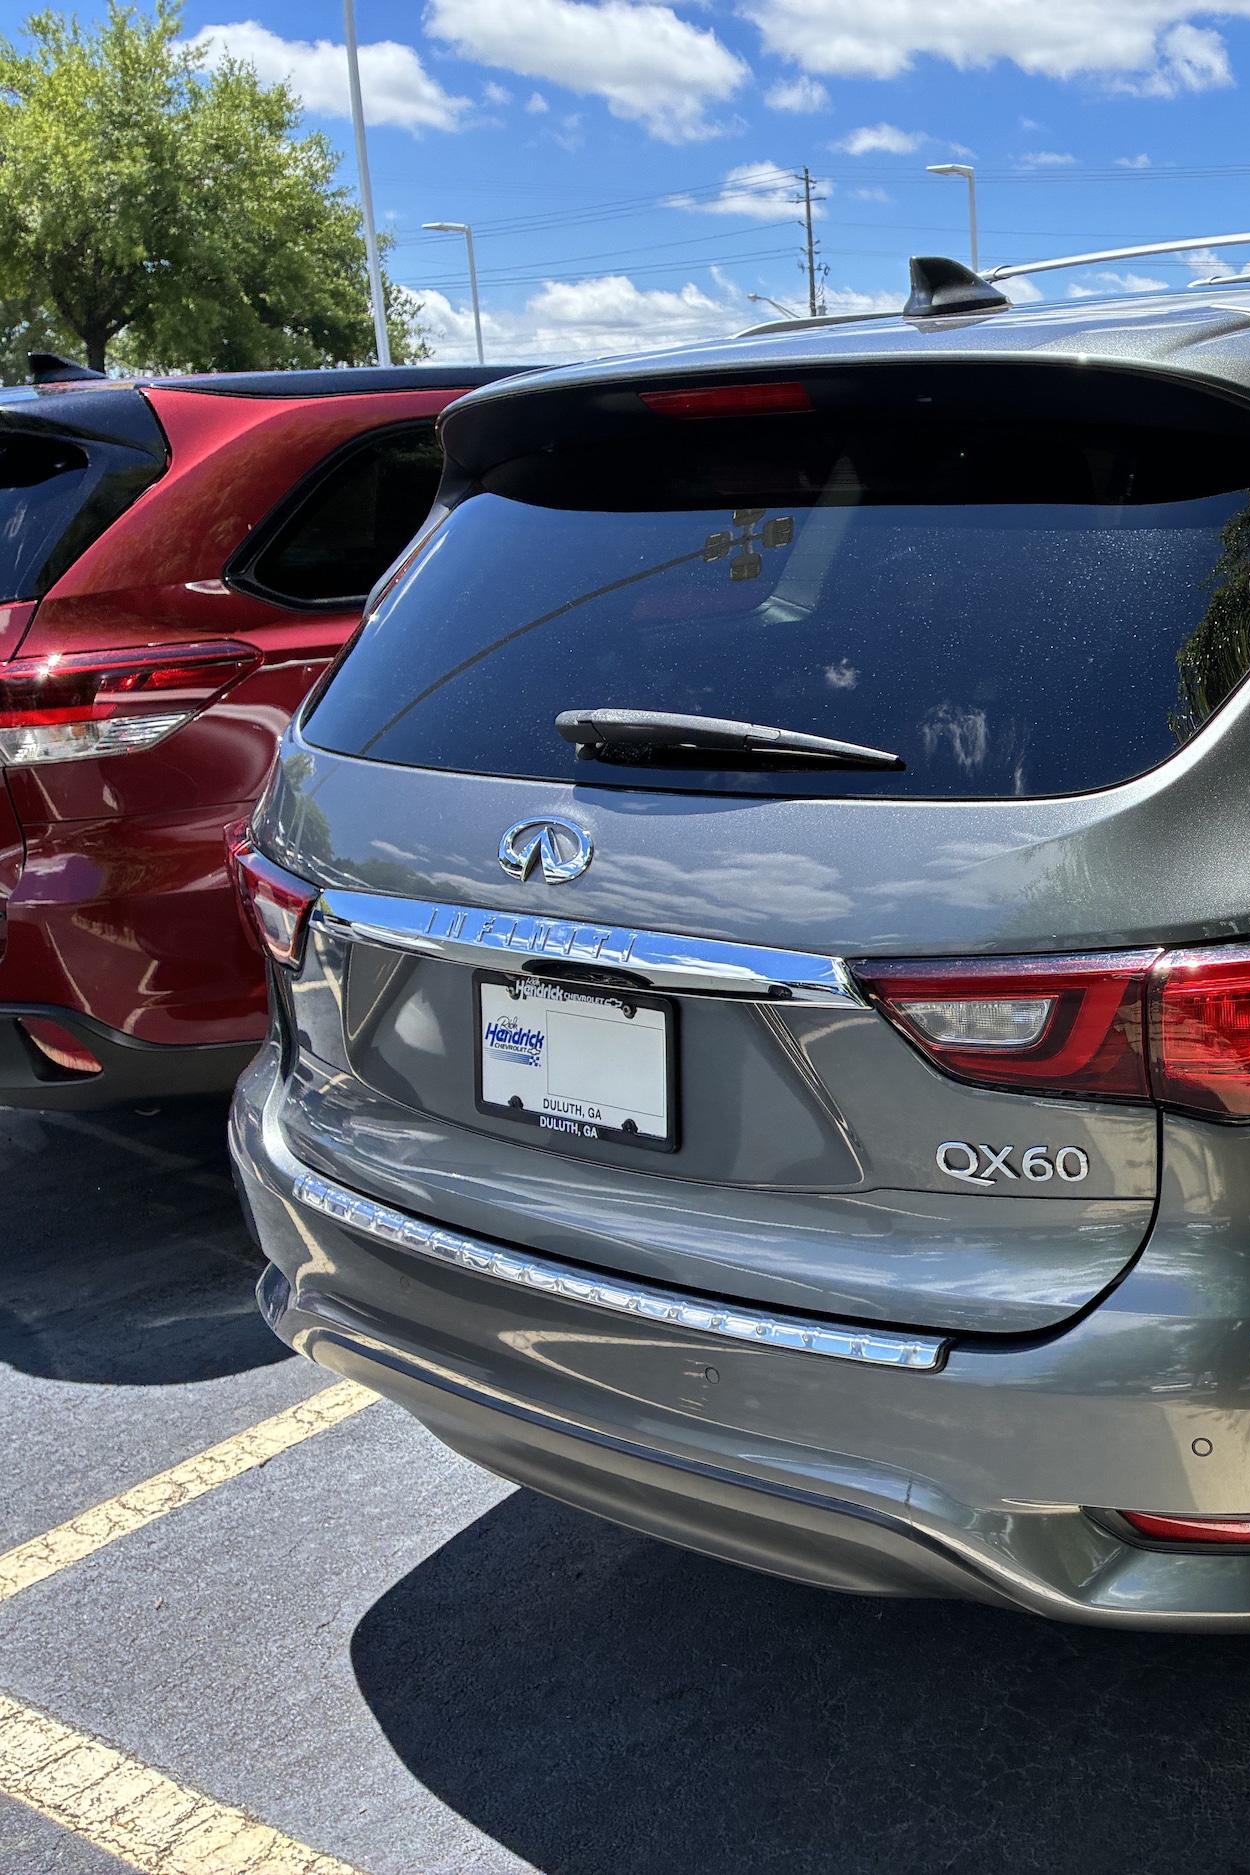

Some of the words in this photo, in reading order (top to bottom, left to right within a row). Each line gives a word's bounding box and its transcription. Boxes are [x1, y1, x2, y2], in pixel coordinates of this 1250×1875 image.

[424, 907, 638, 963] INFINITI
[515, 980, 564, 1001] Hendrick
[563, 992, 605, 1006] CHEVROLET
[485, 1022, 545, 1050] Hendrick
[494, 1042, 527, 1053] CHEVROLET
[543, 1098, 586, 1118] DULUTH,
[588, 1107, 602, 1120] GA
[539, 1115, 581, 1136] DULUTH,
[583, 1125, 599, 1138] GA
[936, 1141, 1090, 1187] QX60
